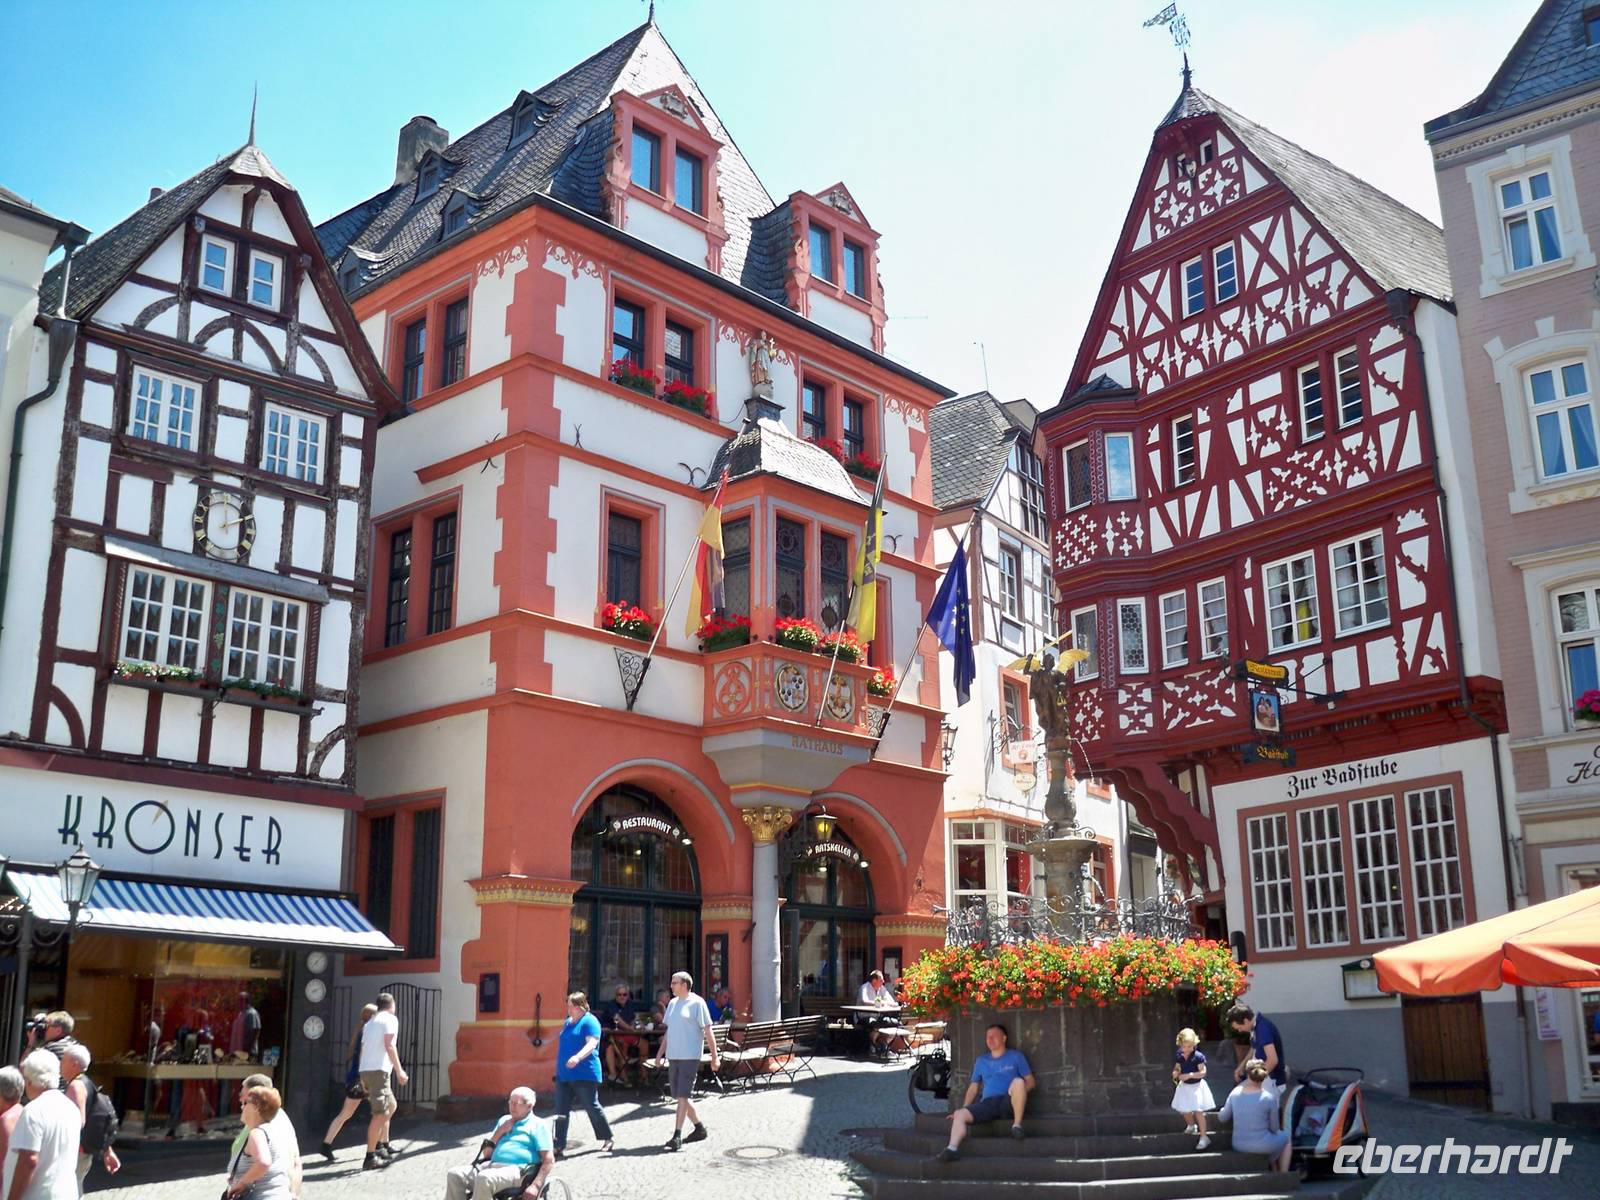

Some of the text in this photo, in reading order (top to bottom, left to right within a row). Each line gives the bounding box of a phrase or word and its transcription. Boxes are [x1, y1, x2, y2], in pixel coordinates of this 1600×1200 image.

[791, 736, 843, 756] RATHAUS
[1287, 775, 1318, 798] Zur
[57, 794, 282, 866] KRONSER
[622, 816, 672, 835] RESTAURANT
[814, 842, 852, 858] RATSKELLER
